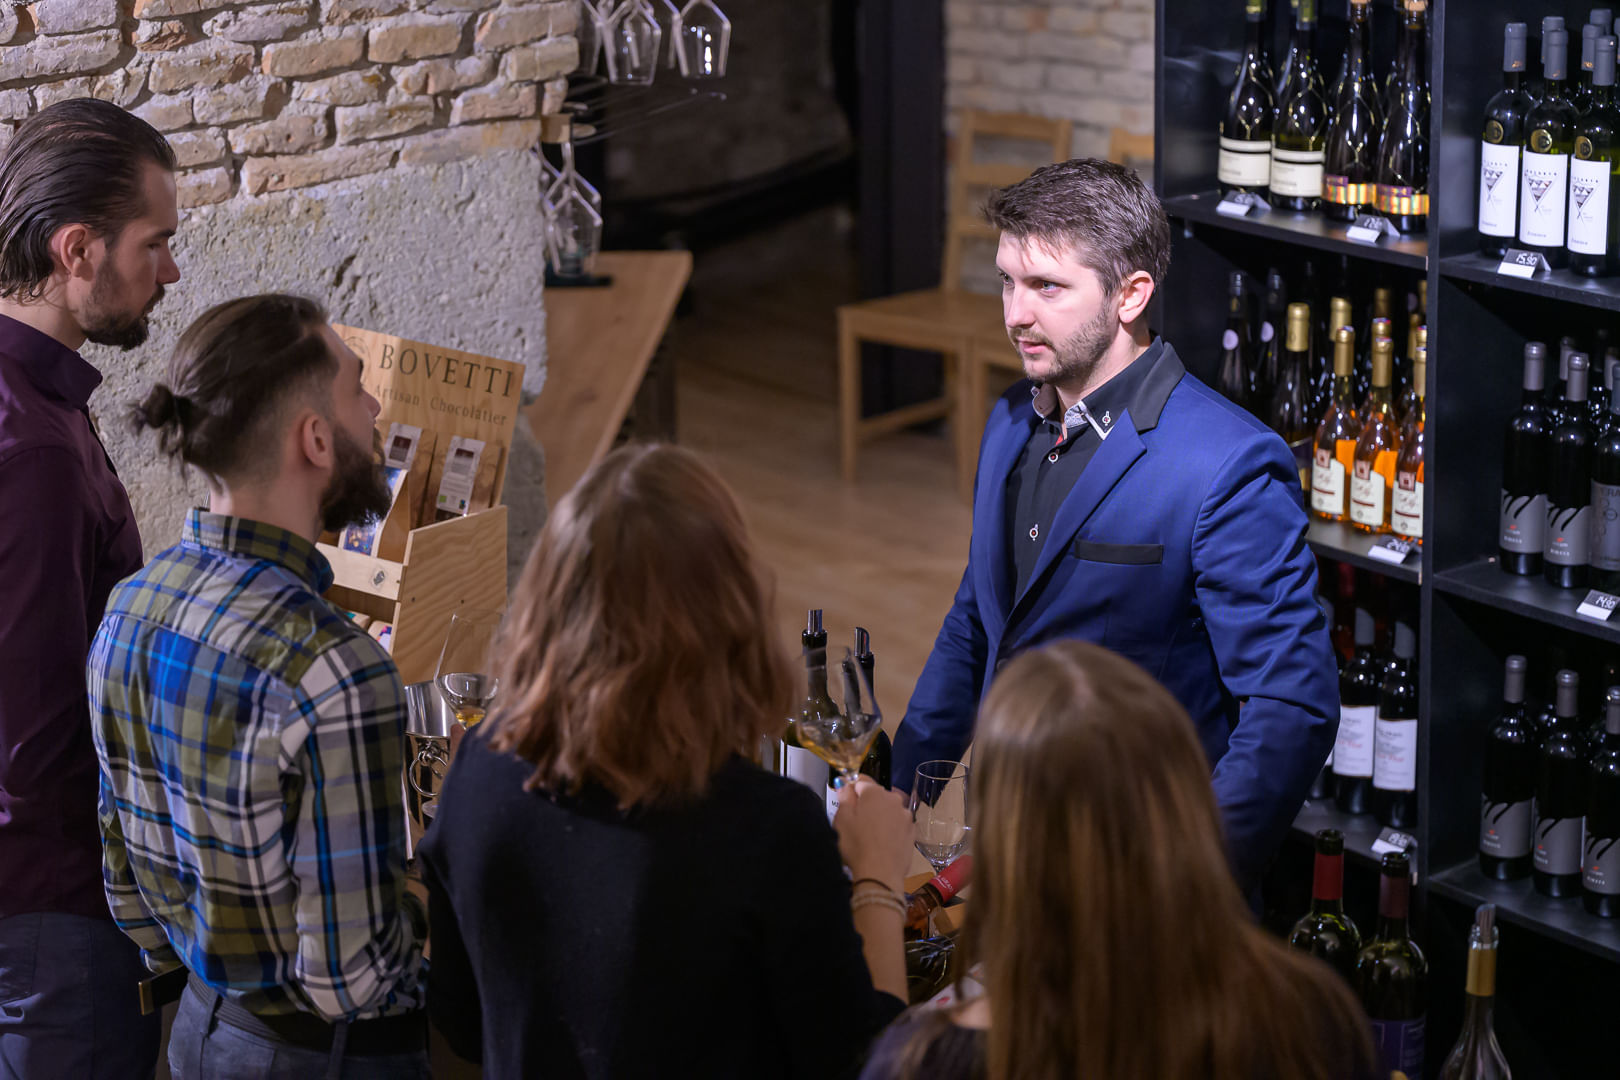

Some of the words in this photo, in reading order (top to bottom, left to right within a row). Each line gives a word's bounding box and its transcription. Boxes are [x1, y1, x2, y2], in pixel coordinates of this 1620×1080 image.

[380, 343, 514, 396] BOVETTI
[374, 385, 420, 406] Artisan
[430, 396, 507, 426] Chocolatier
